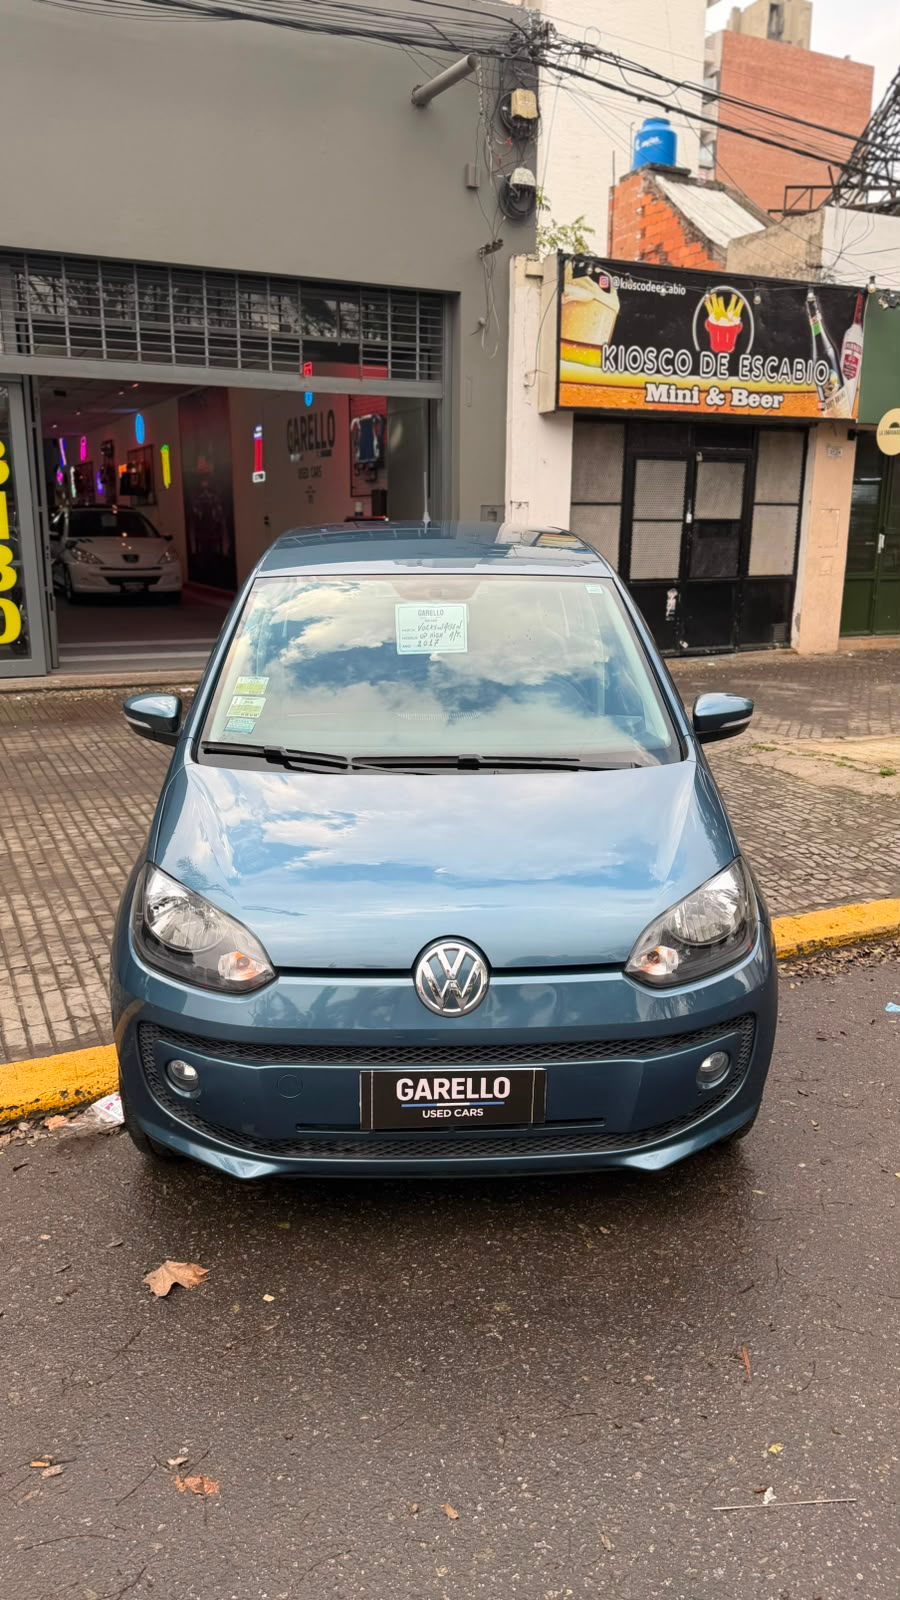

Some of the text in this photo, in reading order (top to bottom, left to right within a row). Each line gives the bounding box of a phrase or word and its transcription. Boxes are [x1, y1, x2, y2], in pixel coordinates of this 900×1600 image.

[601, 344, 693, 376] KIOSCO
[700, 352, 729, 380] DE
[738, 354, 830, 386] ESCABIO
[645, 382, 784, 409] Mini & Beer
[286, 409, 336, 454] GARELLO
[417, 609, 444, 617] GARELLO
[396, 1076, 511, 1101] GARELLO
[422, 1108, 484, 1118] USED CARS
